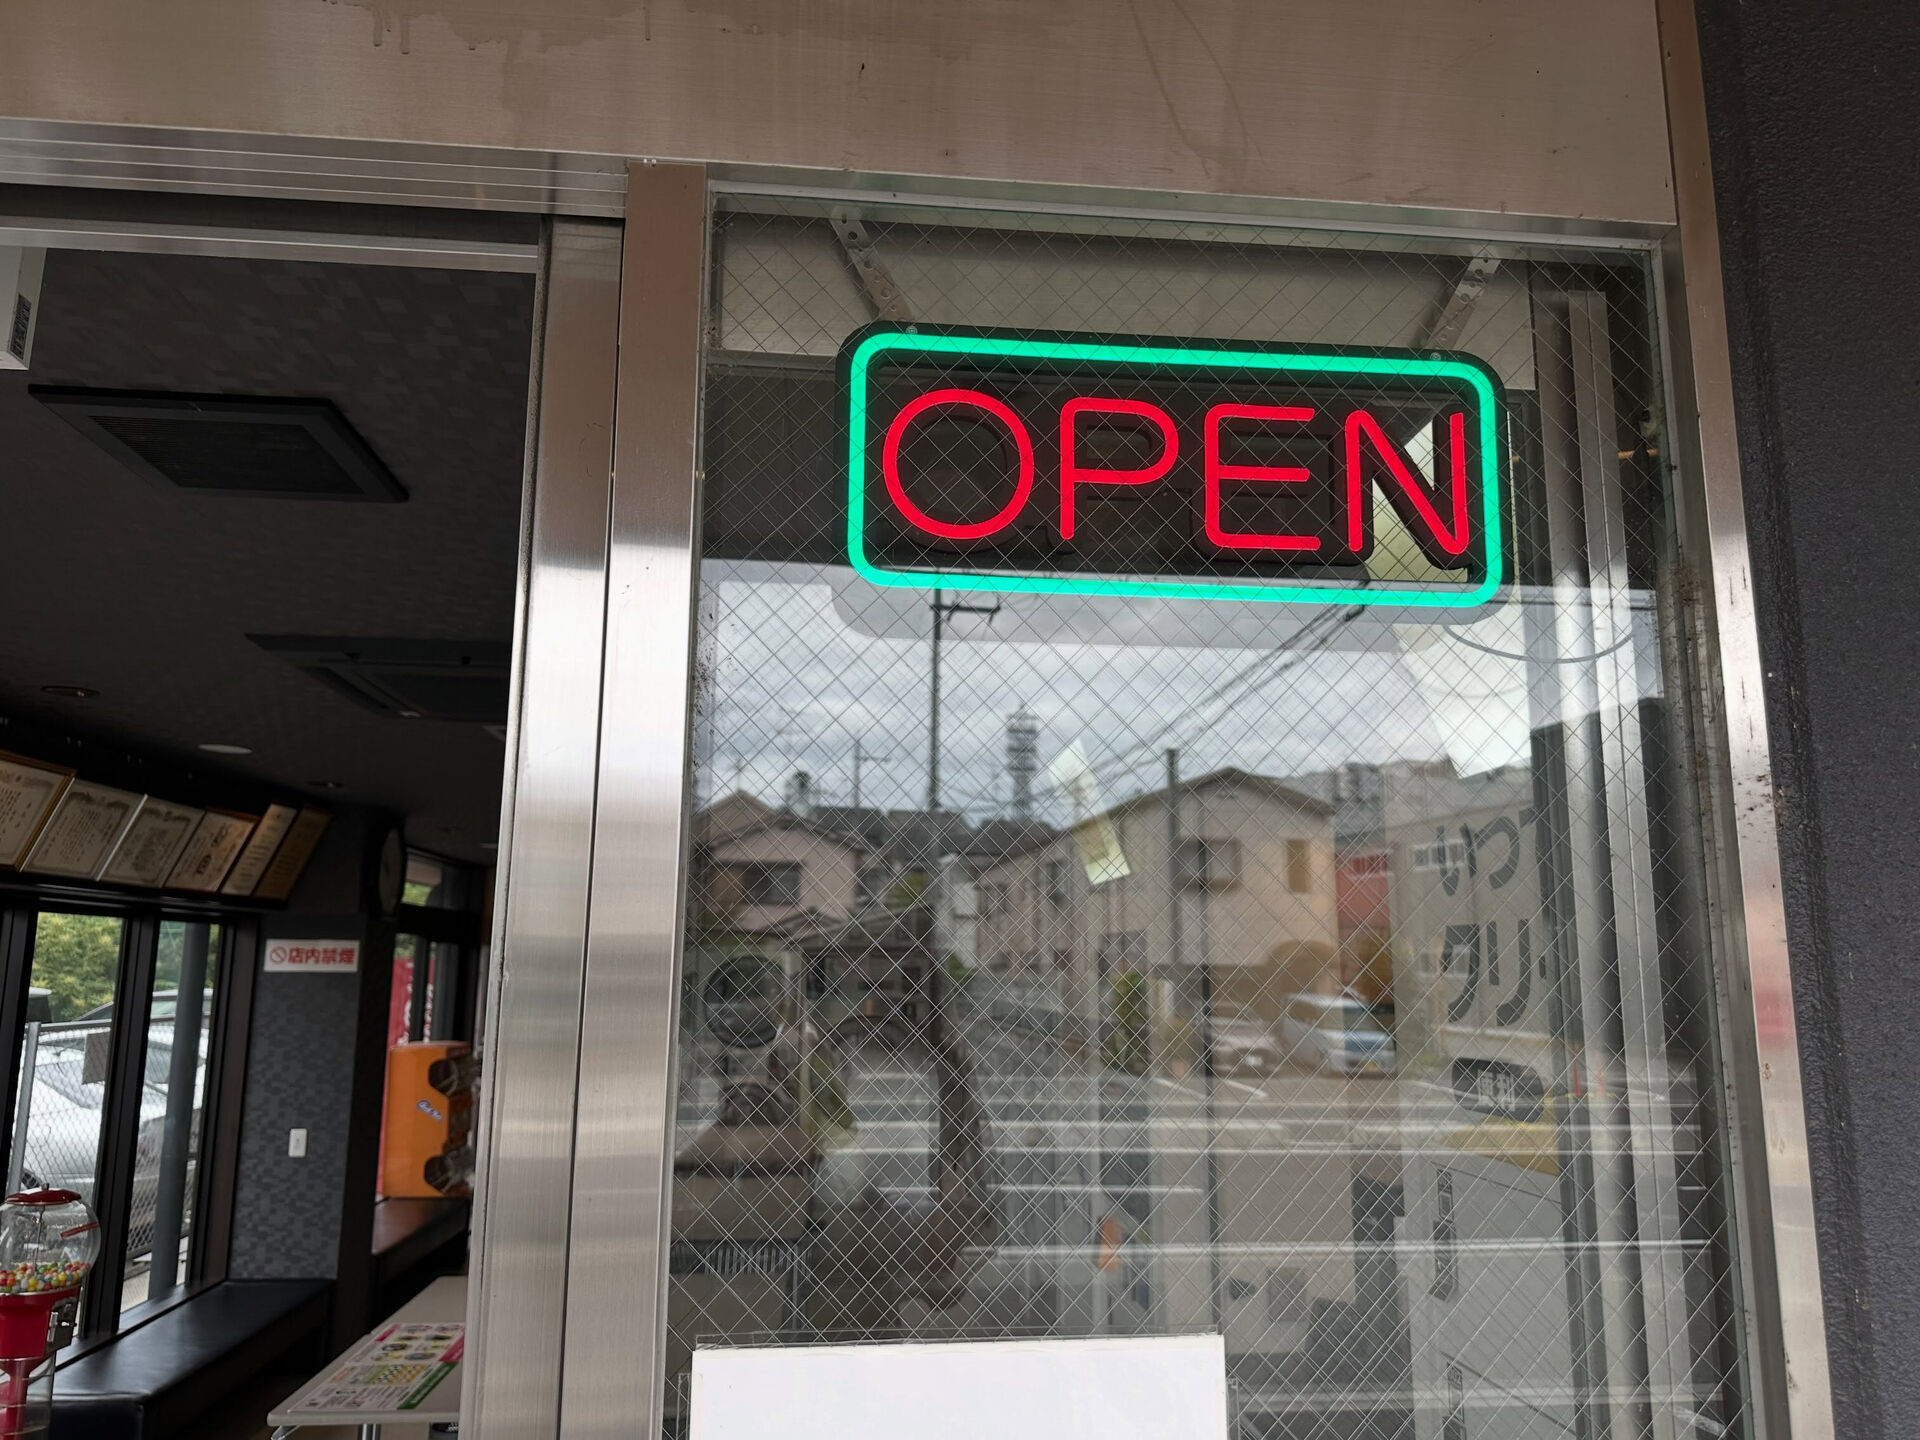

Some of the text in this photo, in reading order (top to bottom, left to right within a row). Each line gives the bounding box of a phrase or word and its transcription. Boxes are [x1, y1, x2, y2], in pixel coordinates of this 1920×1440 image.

[883, 388, 1469, 555] OPEN
[288, 946, 356, 965] 店内禁煙
